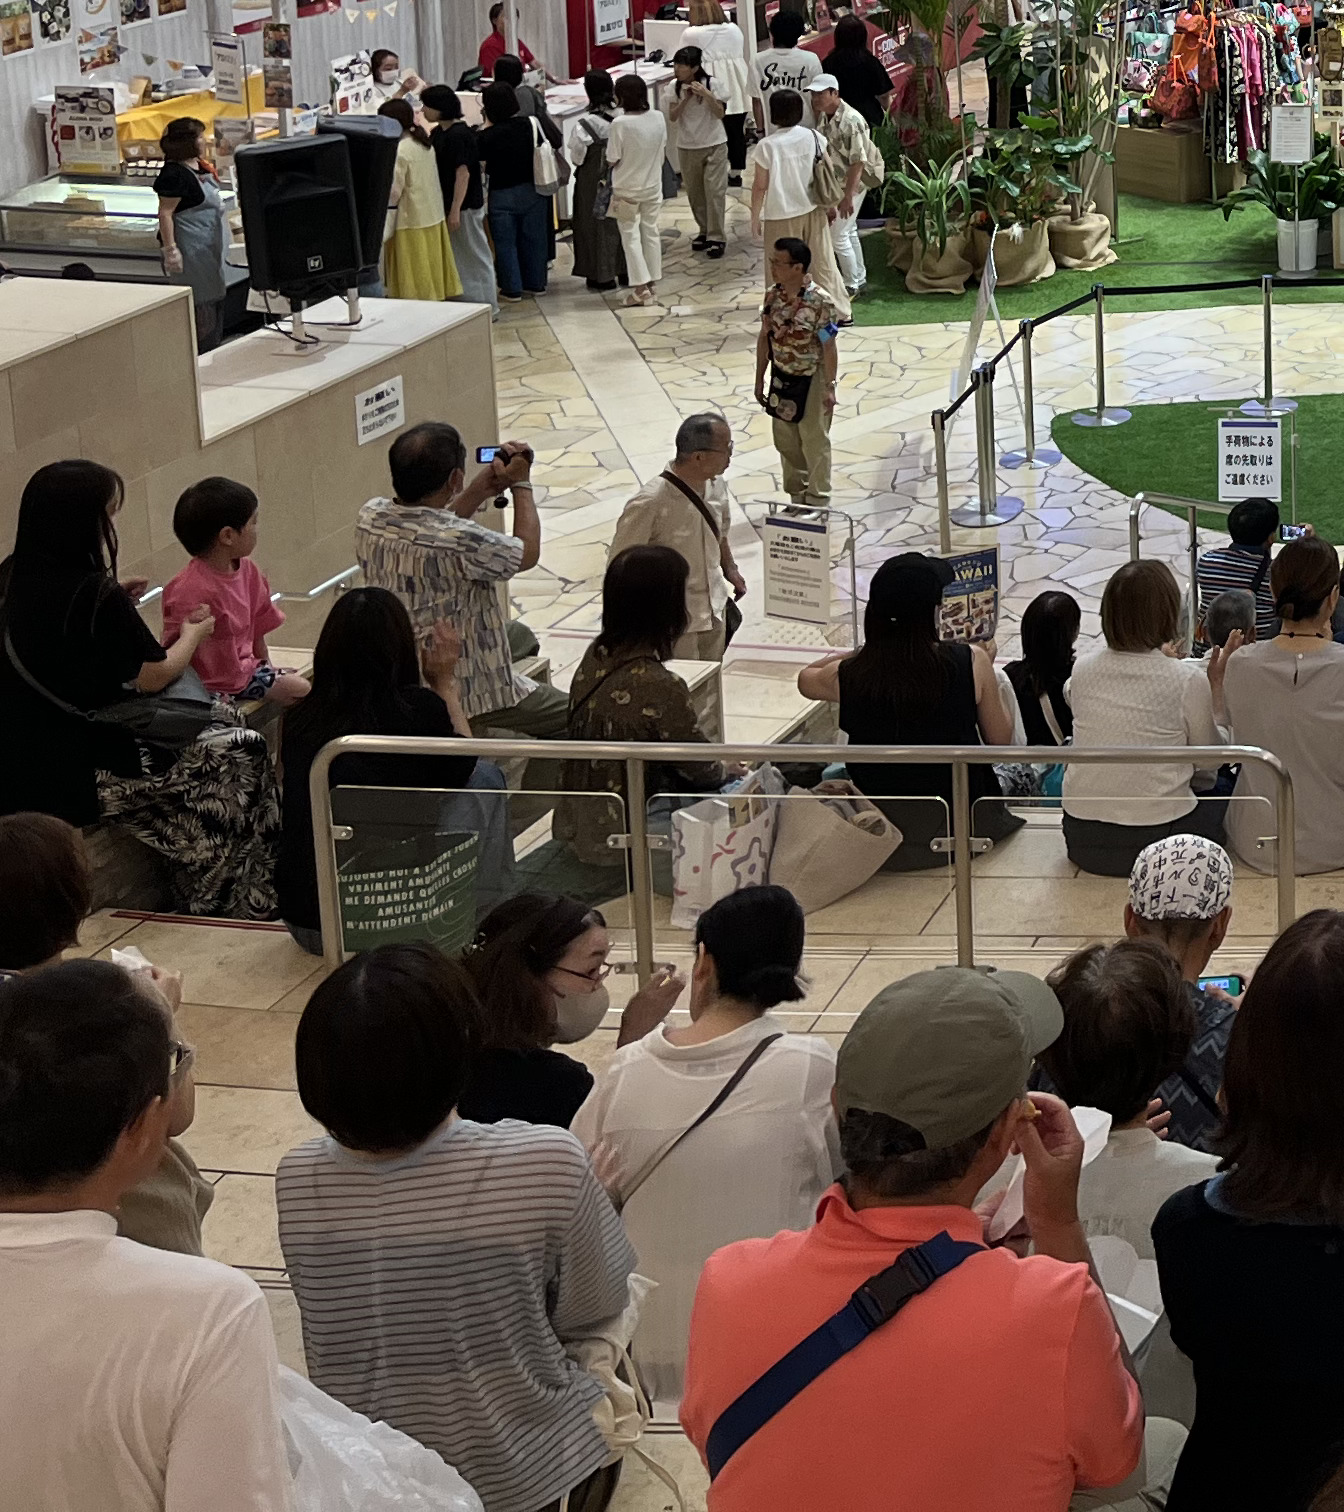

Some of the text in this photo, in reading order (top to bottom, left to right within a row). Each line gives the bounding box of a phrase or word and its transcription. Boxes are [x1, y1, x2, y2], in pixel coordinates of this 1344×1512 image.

[760, 62, 808, 91] Saint
[1225, 434, 1274, 448] 手荷物による
[1225, 472, 1274, 486] ご遠慮ください
[348, 880, 404, 894] VRAIMENT
[363, 890, 414, 905] DEMANDE
[421, 899, 455, 922] DEMAIN
